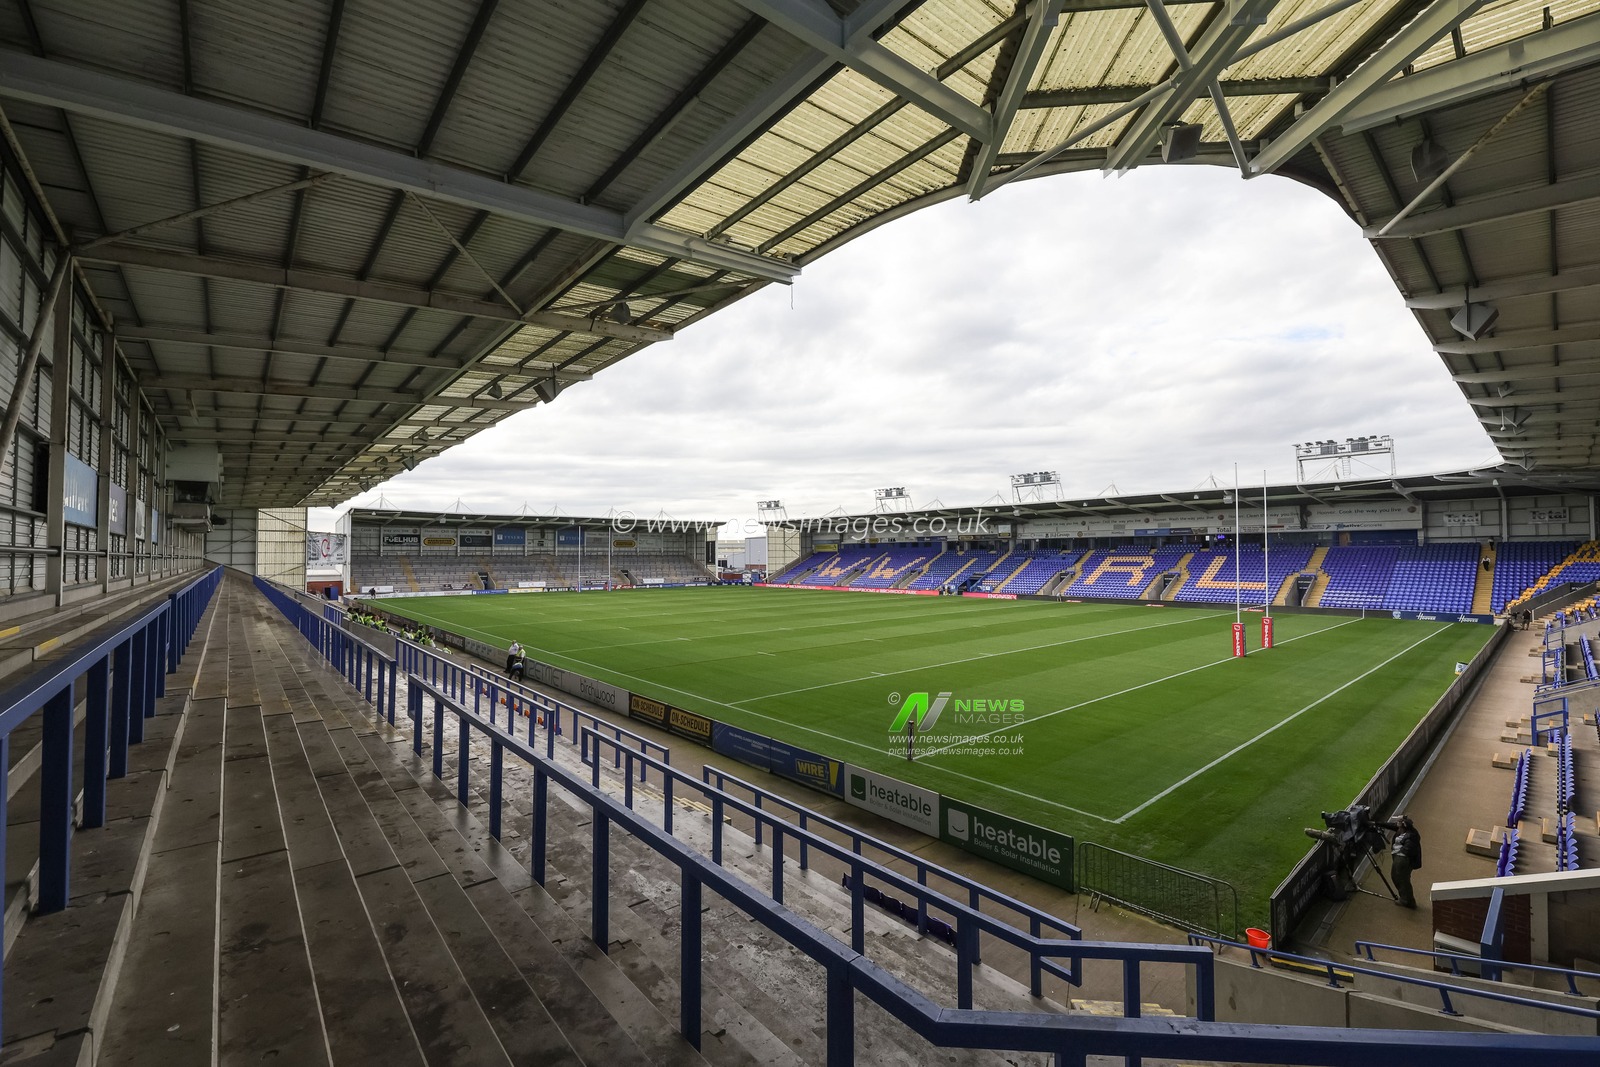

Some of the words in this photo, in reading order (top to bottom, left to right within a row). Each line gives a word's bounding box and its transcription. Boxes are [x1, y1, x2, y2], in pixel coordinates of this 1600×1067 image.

[1530, 508, 1567, 520] Total
[580, 677, 616, 705] birchwood
[632, 696, 664, 718] ON-SCHEDULE
[671, 712, 709, 734] ON-SCHEDULE
[797, 760, 825, 778] WIRE
[869, 779, 932, 817] heatable
[973, 816, 1061, 864] heatable
[973, 837, 993, 851] Boiler
[1000, 846, 1018, 859] Solar
[1019, 854, 1061, 876] Installation
